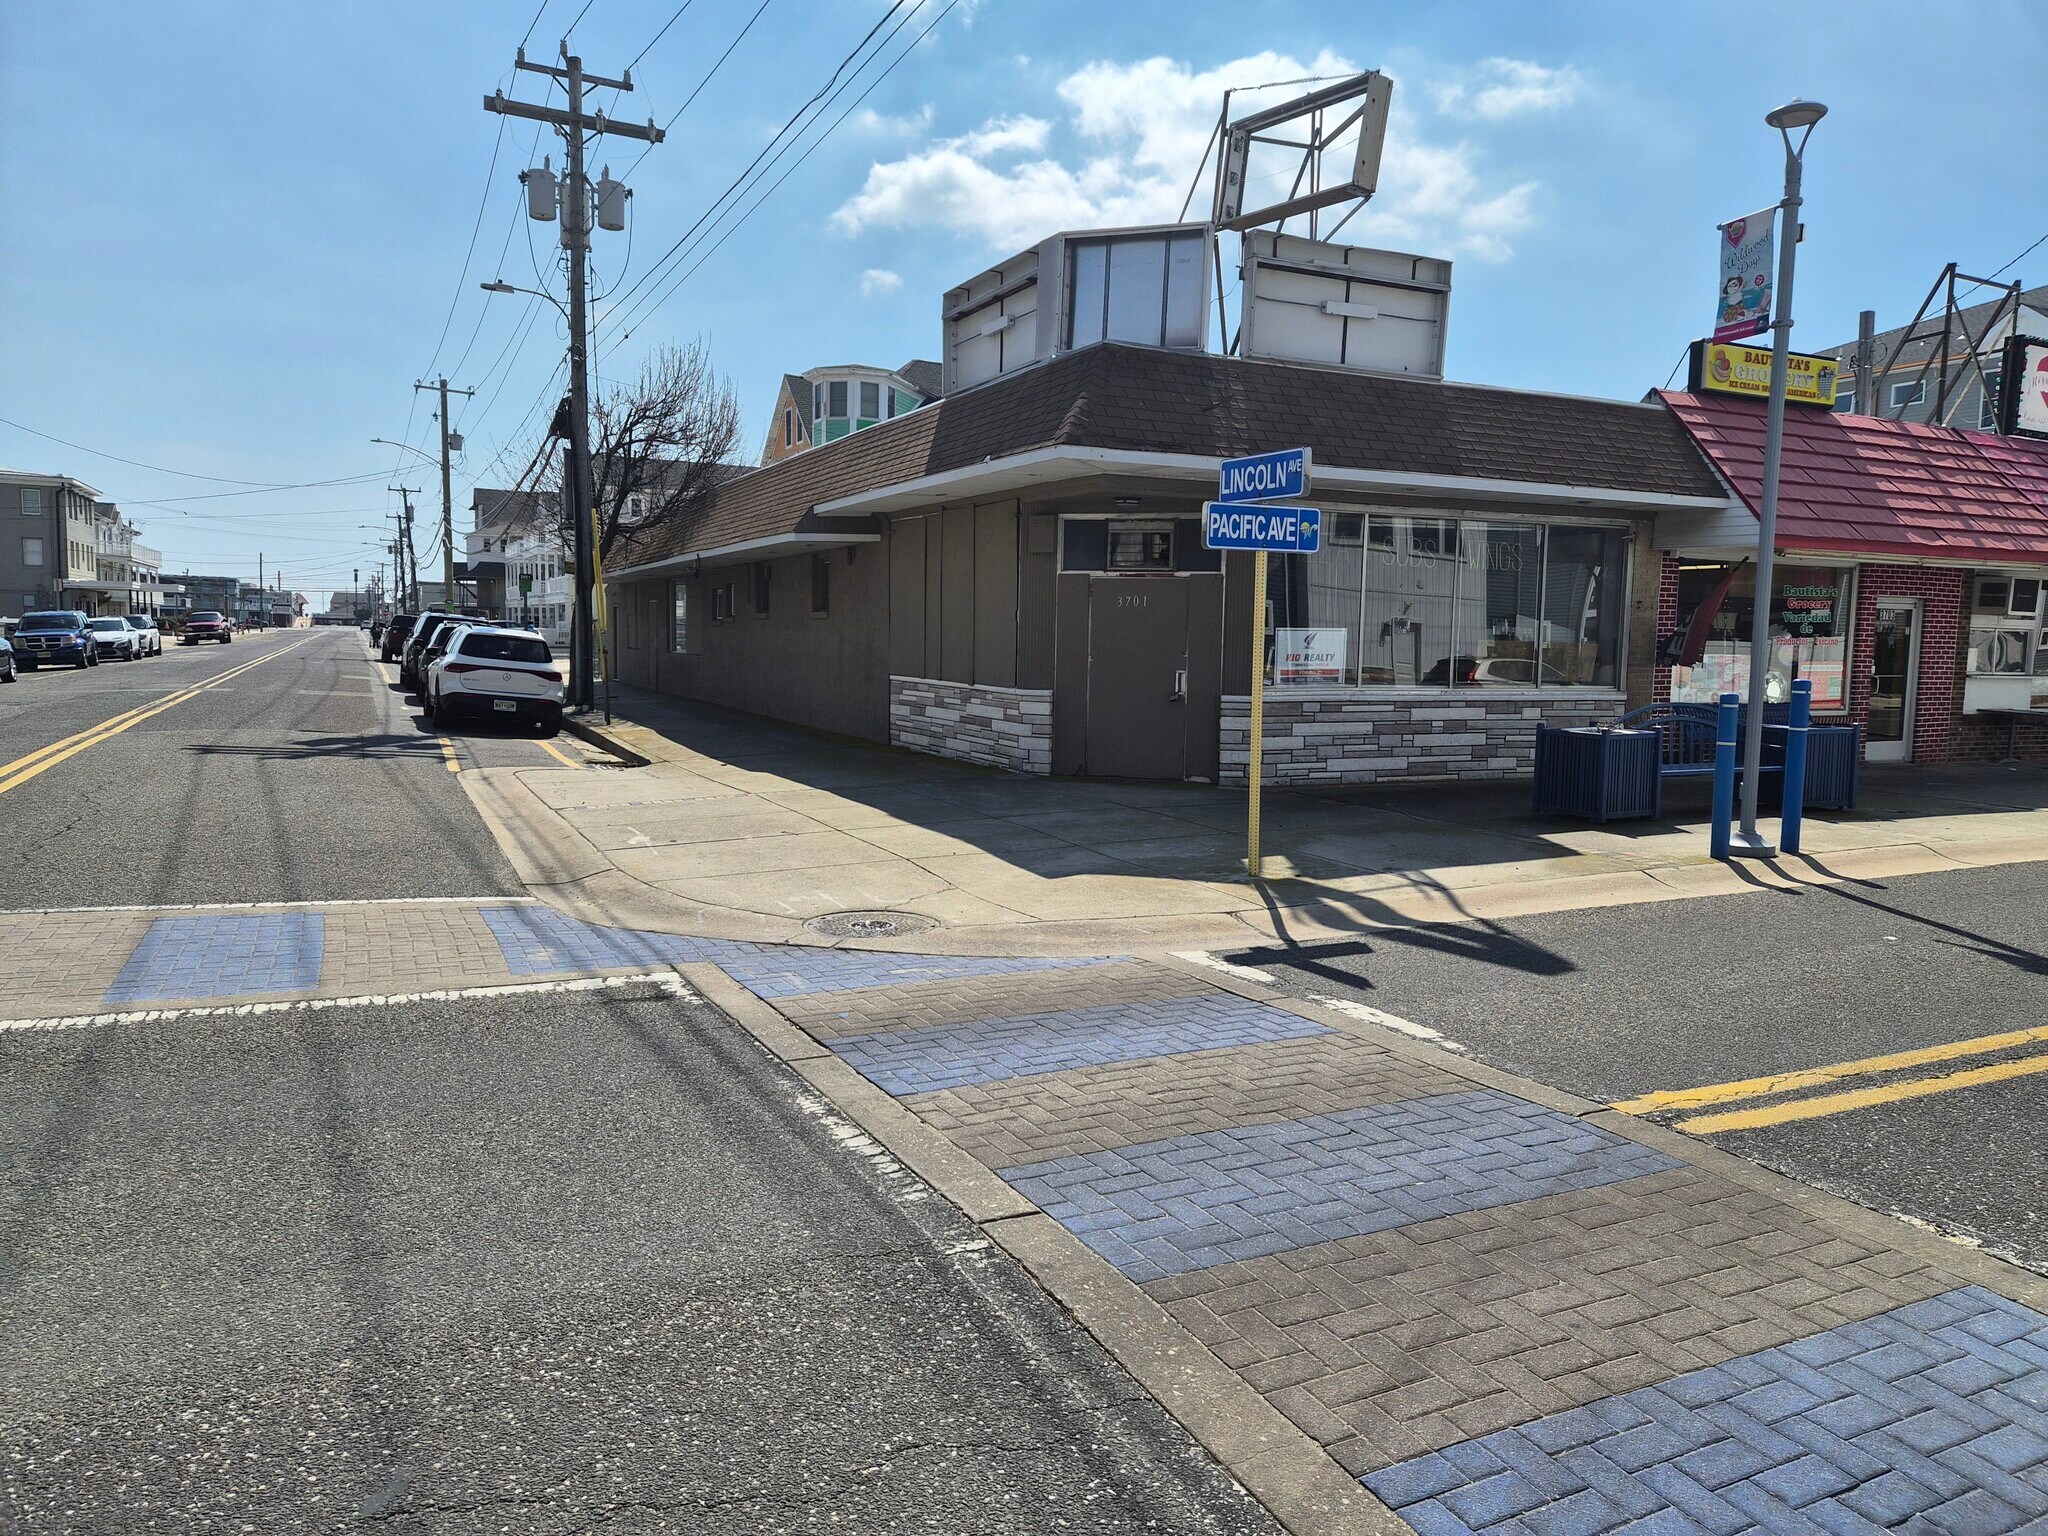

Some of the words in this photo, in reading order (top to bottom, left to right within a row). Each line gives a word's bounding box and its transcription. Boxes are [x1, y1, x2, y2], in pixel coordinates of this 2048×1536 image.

[1725, 229, 1769, 269] Wildwood
[1738, 255, 1761, 275] Days
[1745, 352, 1811, 371] BAUTA'S
[1729, 380, 1739, 388] ICE
[1739, 382, 1760, 391] CREAM
[1787, 388, 1817, 398] AMERICAN
[1221, 461, 1287, 494] LINCOLN
[1288, 458, 1302, 473] AVE
[1210, 513, 1266, 540] PACIFIC
[1267, 516, 1296, 541] AVE
[1382, 536, 1437, 569] SUBS
[1468, 542, 1523, 572] WINGS
[1783, 585, 1838, 598] Bautista's
[1117, 596, 1148, 608] 3701
[1787, 598, 1832, 610] Grocery
[1782, 611, 1832, 623] Variedad
[1800, 623, 1814, 634] de
[1776, 636, 1809, 646] Productos
[1286, 654, 1301, 662] RIO
[1304, 654, 1335, 662] REALTY
